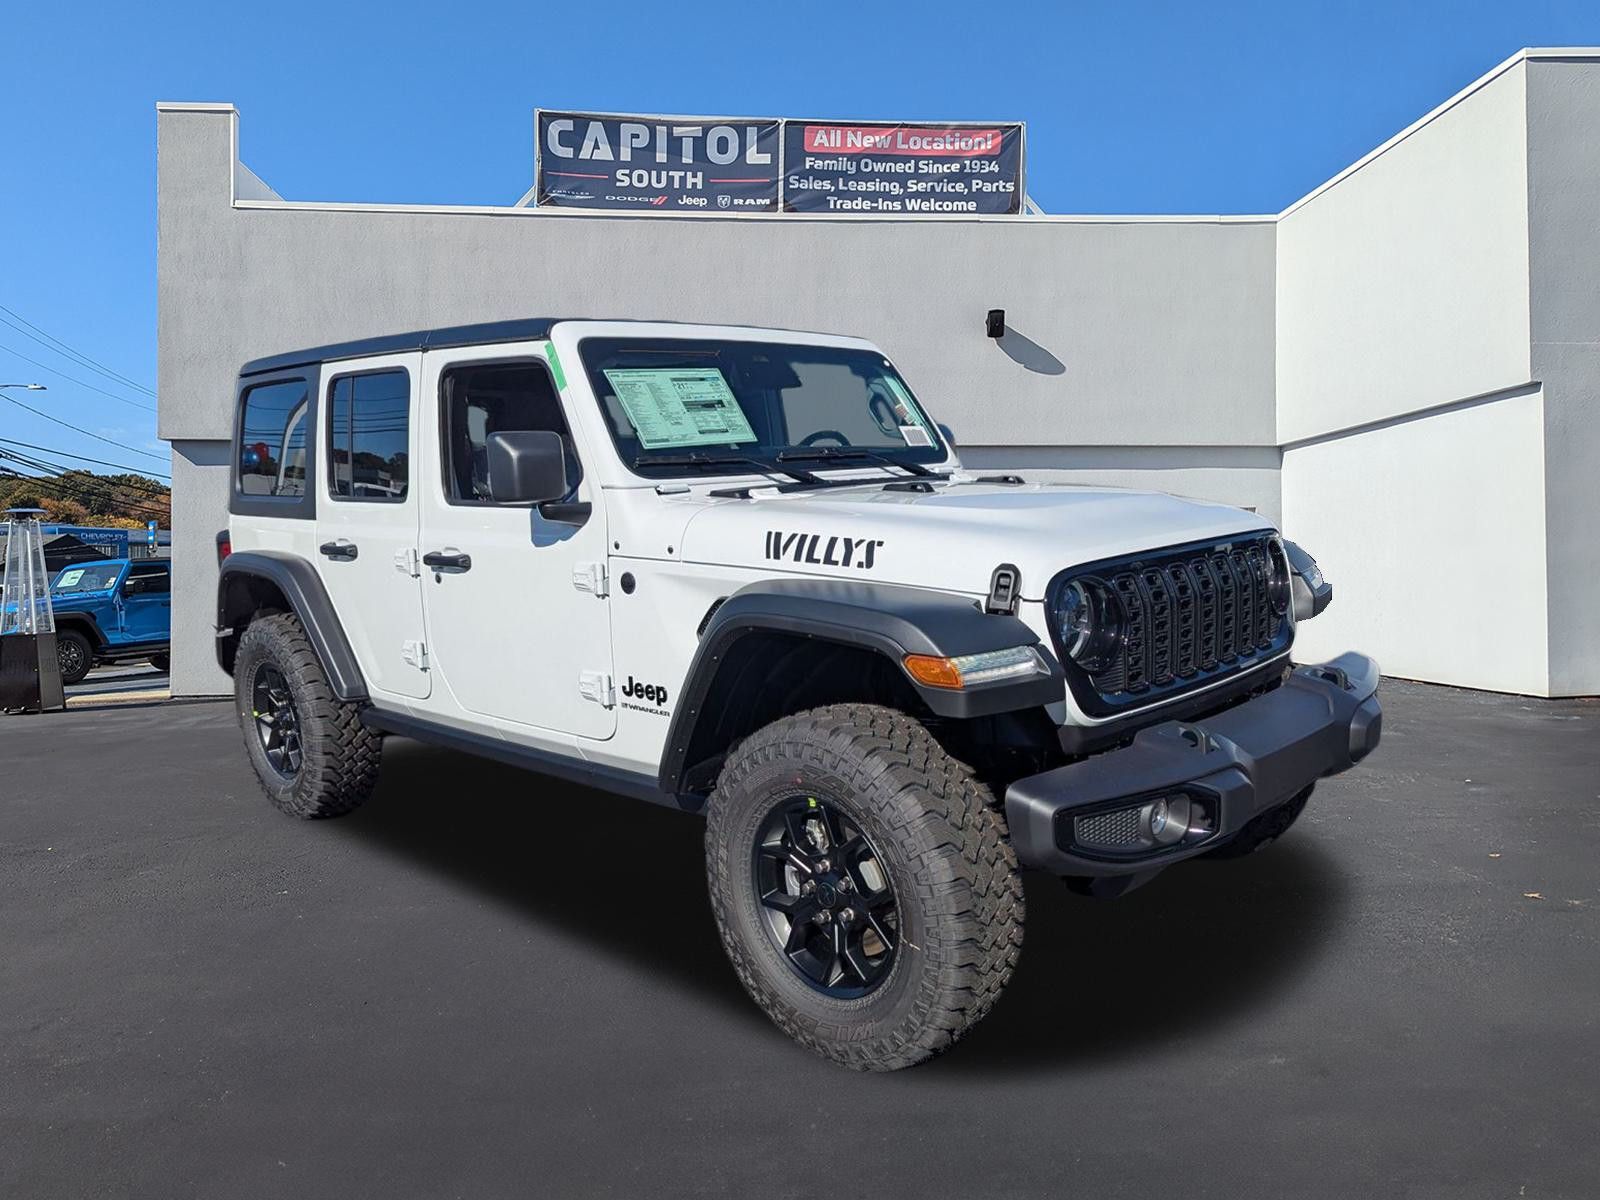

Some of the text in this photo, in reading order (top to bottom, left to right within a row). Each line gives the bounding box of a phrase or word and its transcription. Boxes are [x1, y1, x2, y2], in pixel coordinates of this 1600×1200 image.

[547, 119, 771, 165] CAPITOL
[813, 130, 993, 151] All New Location!
[805, 157, 1000, 174] Family Owned Since 1934
[615, 169, 703, 189] SOUTH
[789, 176, 1015, 195] Sales, Leasing, Service, Parts
[605, 195, 656, 203] DODGE
[678, 195, 708, 208] Jeep
[733, 198, 771, 206] RAM
[826, 196, 977, 212] Trade-Ins Welcome
[765, 530, 885, 570] WILLYS
[621, 675, 668, 707] Jeep
